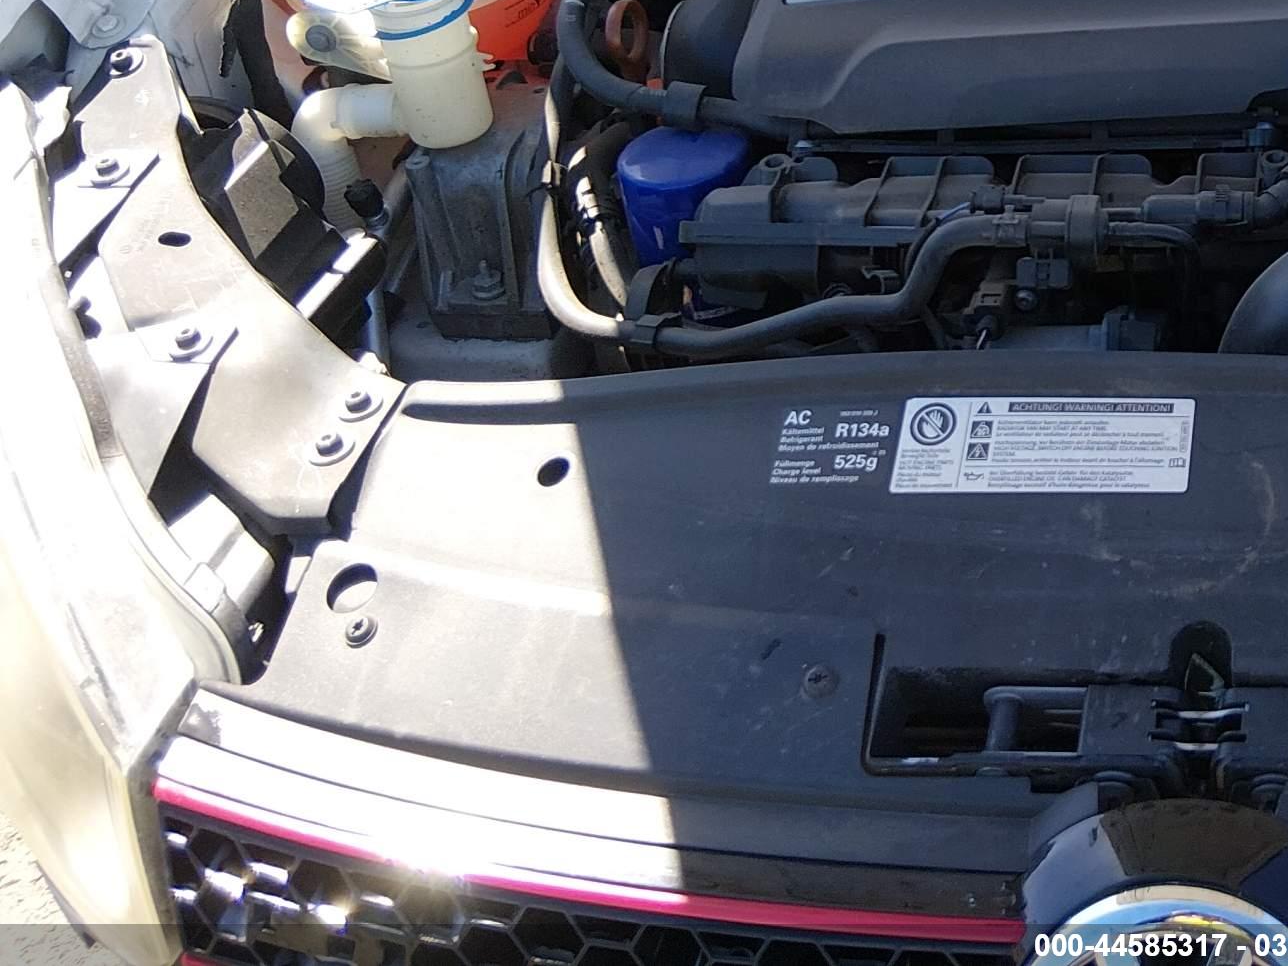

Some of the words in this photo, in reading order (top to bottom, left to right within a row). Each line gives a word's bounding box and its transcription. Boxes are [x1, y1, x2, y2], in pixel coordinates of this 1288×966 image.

[1013, 402, 1063, 412] ACHTUNG!
[1064, 402, 1114, 412] WARNING!
[1115, 403, 1171, 413] ATTENTION!
[785, 410, 812, 425] AC
[835, 422, 890, 438] R134a
[834, 454, 878, 471] 525g
[801, 467, 821, 475] level
